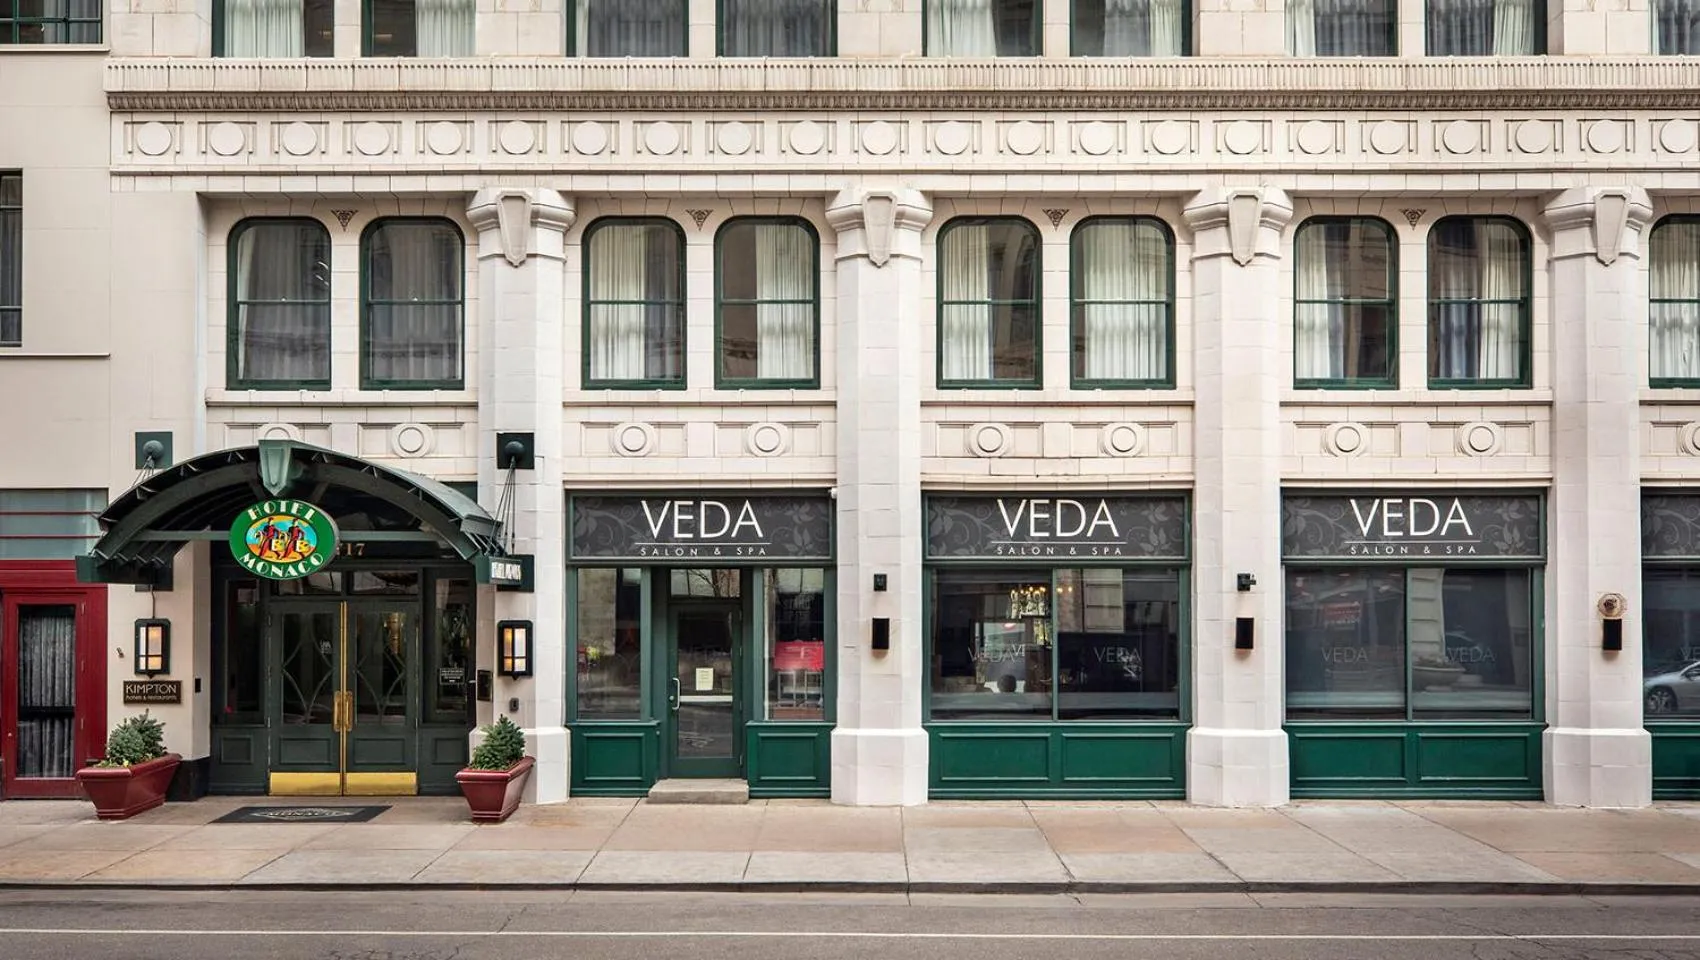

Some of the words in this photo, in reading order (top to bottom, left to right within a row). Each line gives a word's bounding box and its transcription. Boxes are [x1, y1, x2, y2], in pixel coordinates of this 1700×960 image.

[247, 500, 316, 522] HOTEL
[640, 499, 764, 539] VEDA
[996, 498, 1120, 538] VEDA
[1349, 497, 1474, 537] VEDA
[640, 547, 698, 557] SALON
[713, 547, 721, 556] &
[736, 546, 766, 556] SPA
[996, 546, 1054, 555] SALON
[1069, 546, 1077, 555] &
[1091, 546, 1122, 555] SPA
[1350, 545, 1409, 555] SALON
[1423, 545, 1431, 554] &
[1445, 545, 1477, 554] SPA
[240, 552, 324, 578] MONACO
[967, 646, 1015, 663] VEDA
[1093, 646, 1142, 663] VEDA
[1321, 647, 1369, 662] VEDA
[1446, 647, 1496, 663] VEDA
[126, 684, 177, 694] KIMPTON
